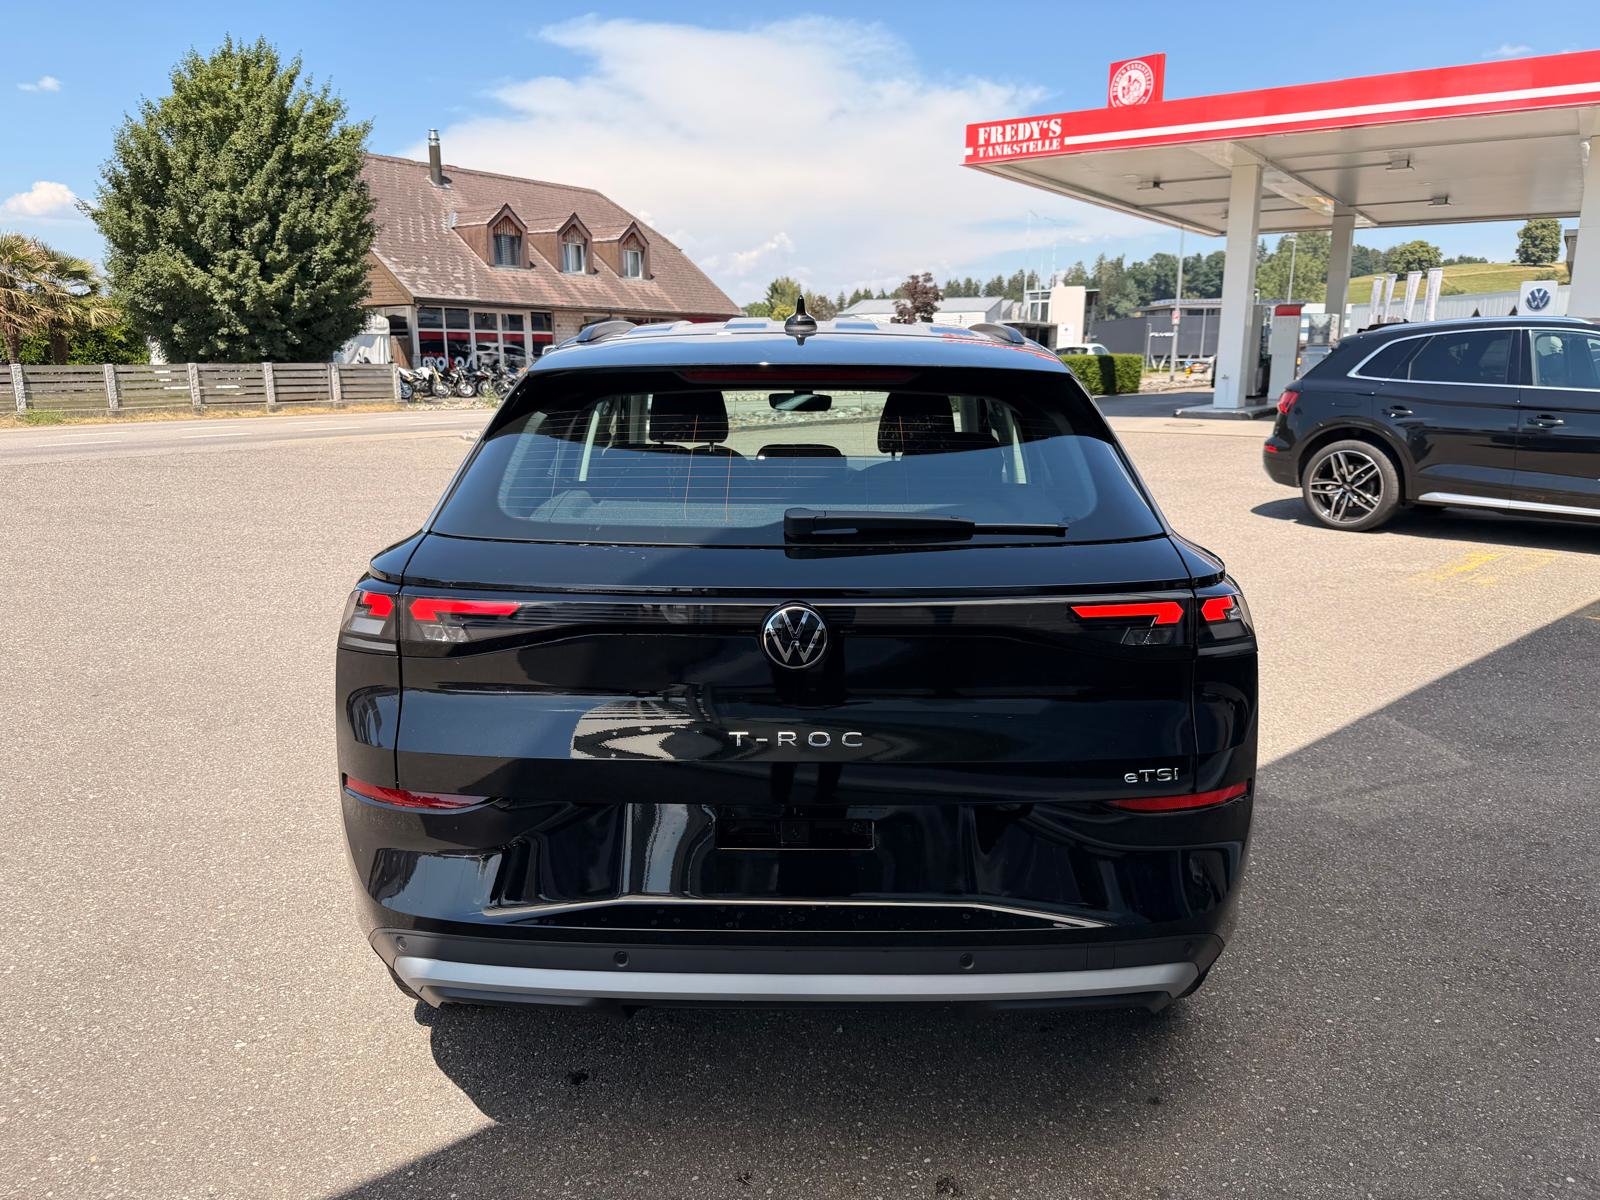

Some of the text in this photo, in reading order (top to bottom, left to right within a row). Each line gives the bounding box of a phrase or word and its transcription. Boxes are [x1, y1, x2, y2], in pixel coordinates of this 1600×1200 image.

[977, 118, 1062, 145] FREDY'S
[977, 138, 1061, 158] TANKSTELLE
[765, 608, 827, 667] VW
[728, 731, 863, 748] T-ROC
